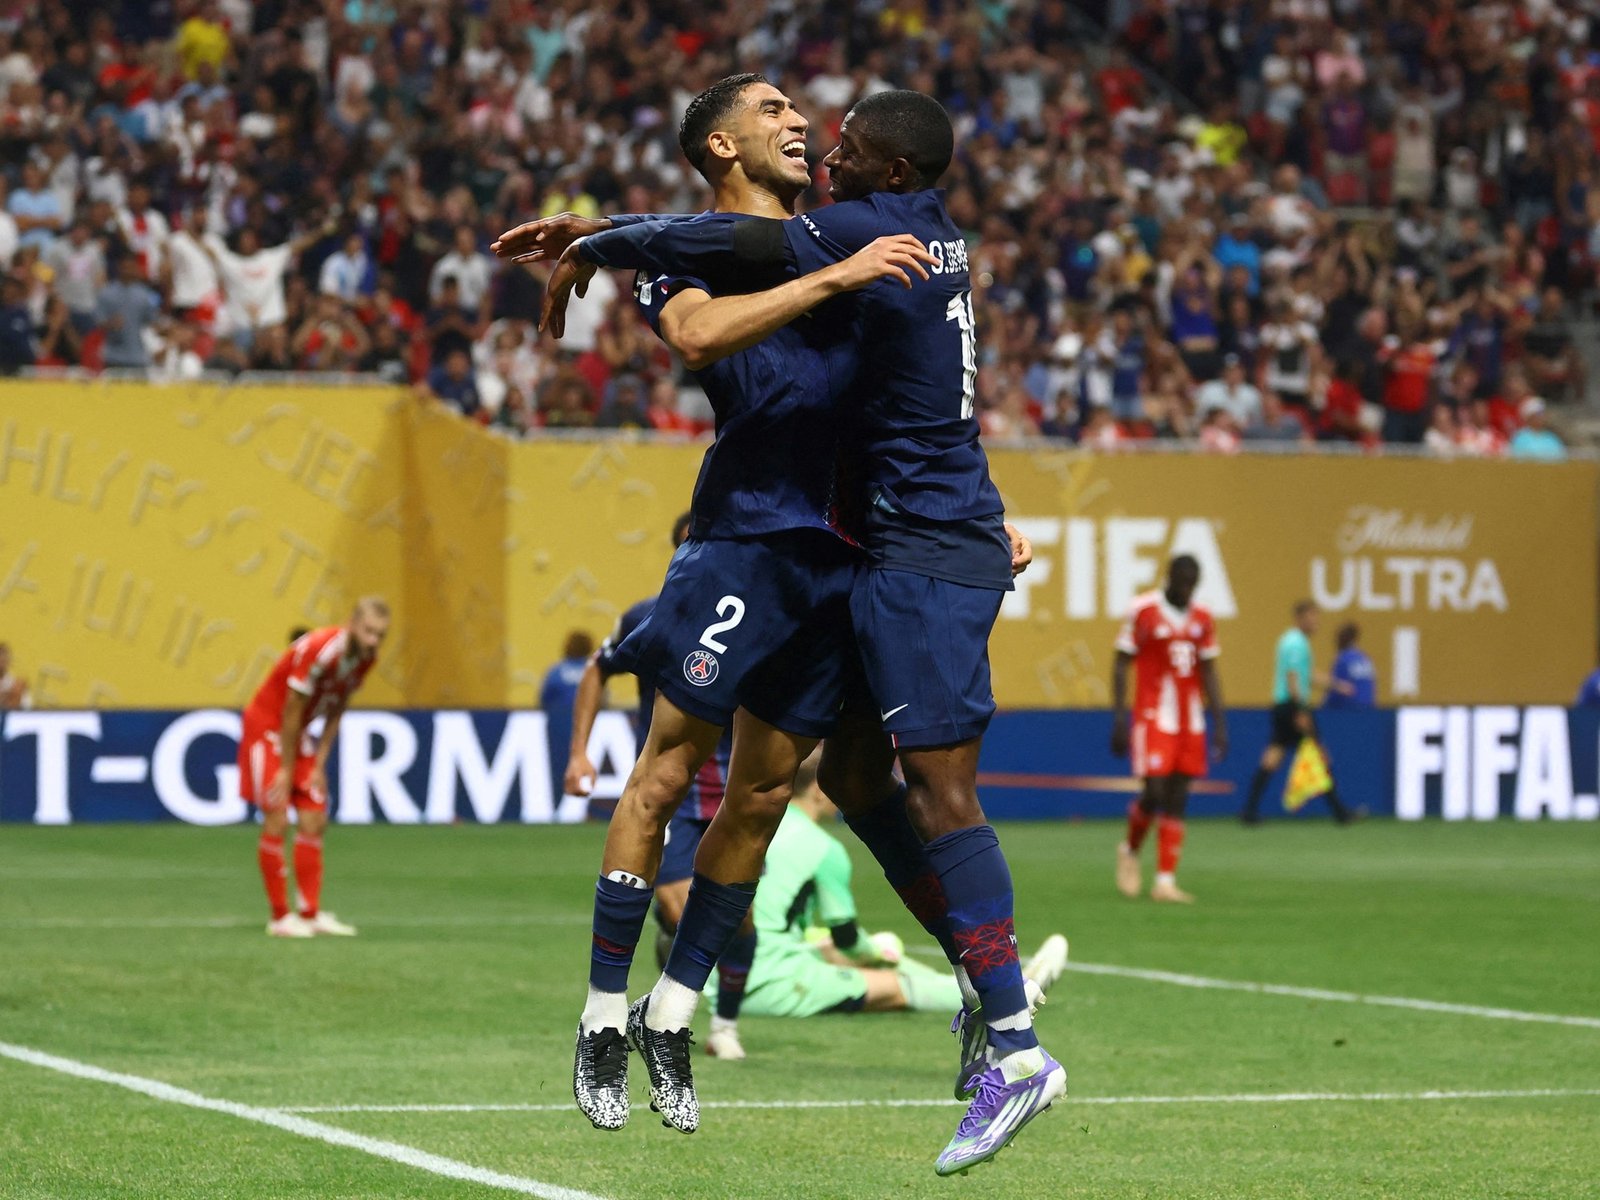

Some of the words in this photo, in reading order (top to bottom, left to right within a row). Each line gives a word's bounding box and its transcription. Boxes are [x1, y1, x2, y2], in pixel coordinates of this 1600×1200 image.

[1003, 516, 1238, 619] FIFA
[1311, 557, 1508, 612] ULTRA
[698, 594, 746, 655] 2
[694, 651, 717, 667] PARIS
[3, 708, 637, 826] T-GRMA
